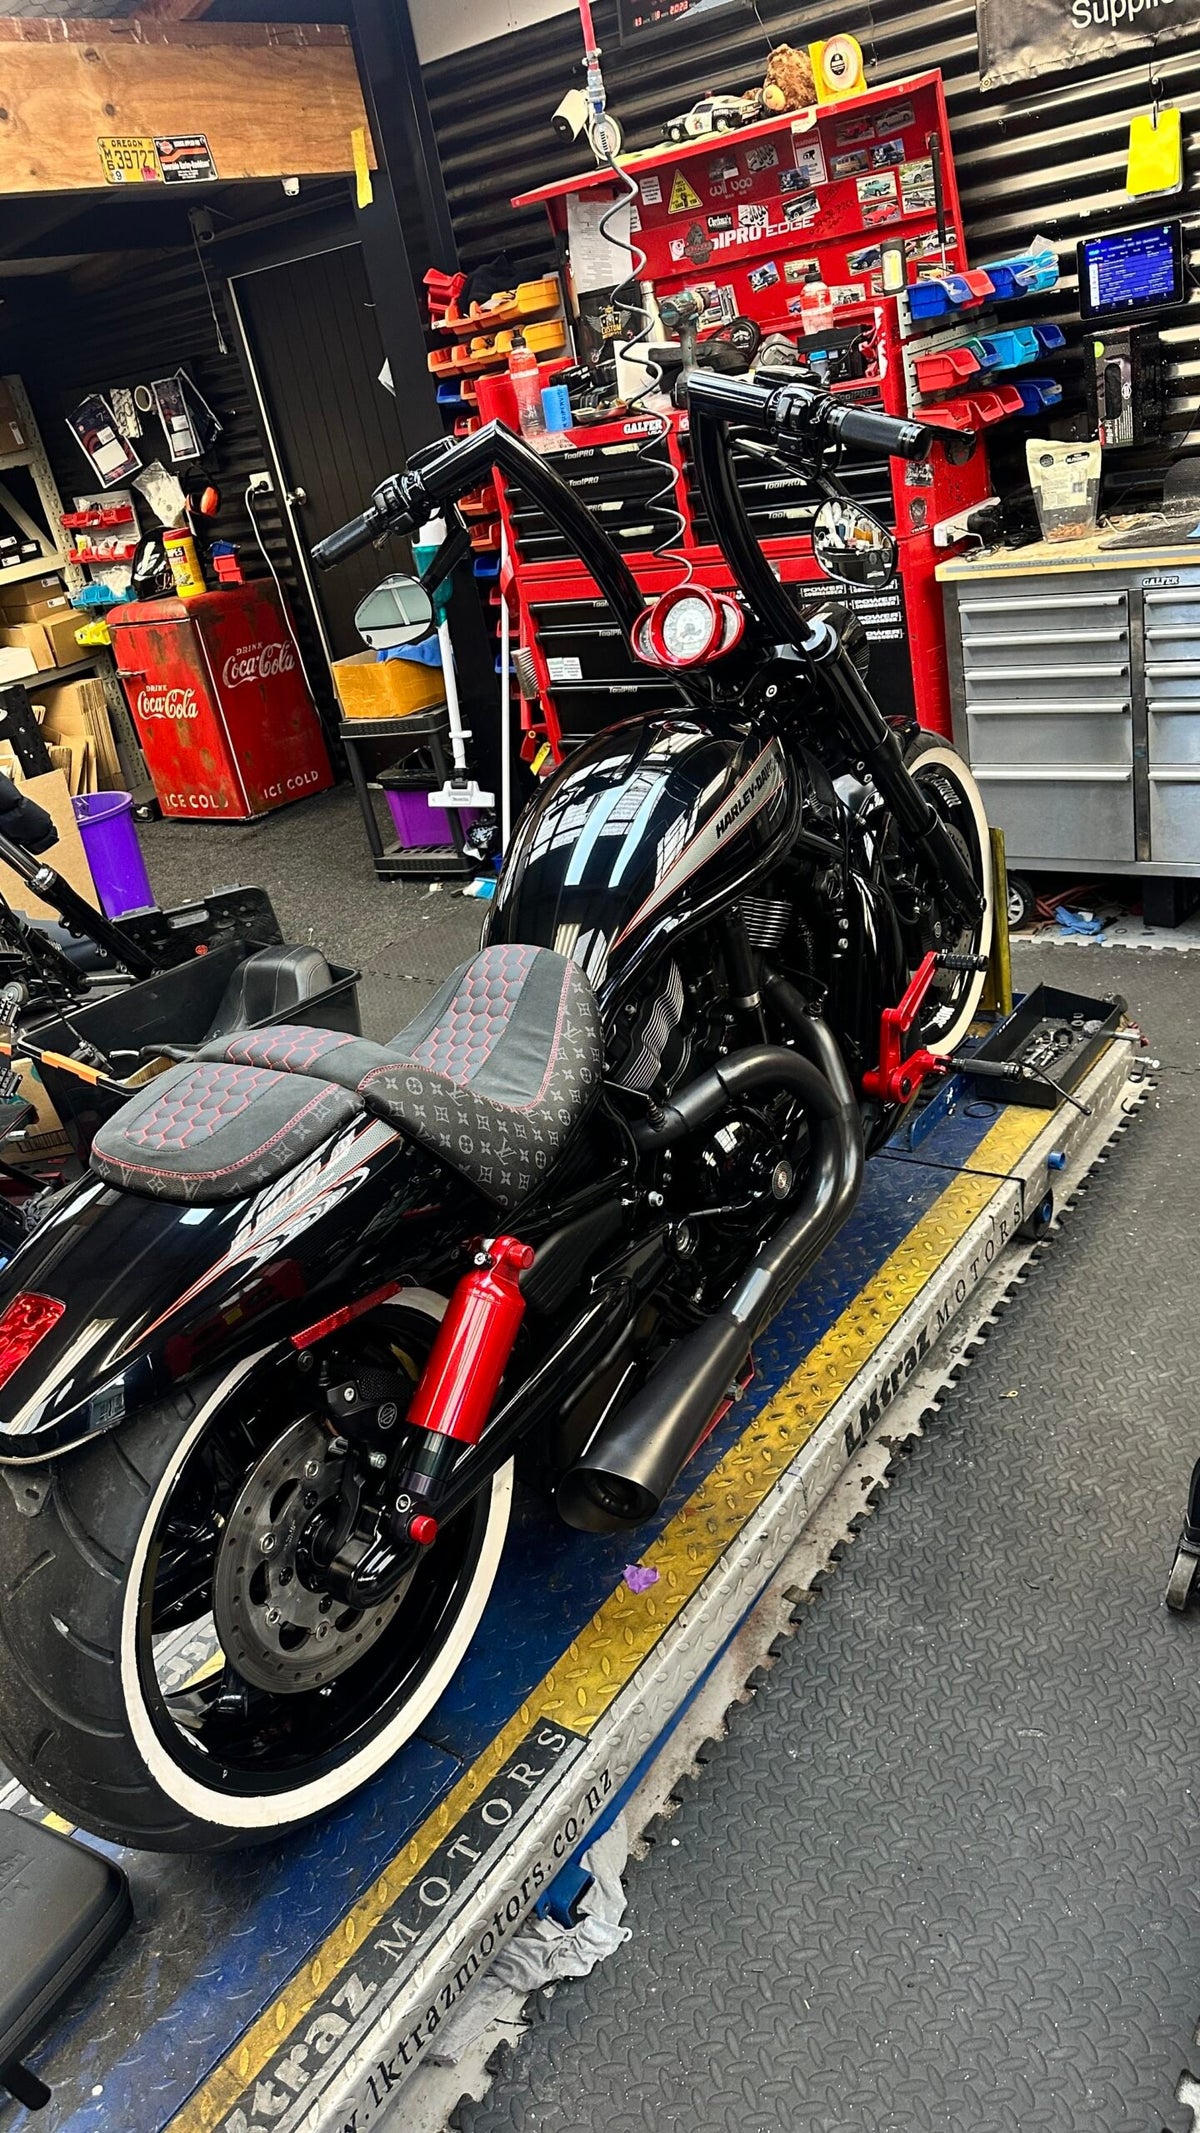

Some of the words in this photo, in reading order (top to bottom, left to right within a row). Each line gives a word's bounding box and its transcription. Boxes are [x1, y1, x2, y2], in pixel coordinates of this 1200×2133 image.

[1072, 0, 1173, 29] Supp
[111, 139, 143, 147] OREGON
[114, 150, 157, 169] 39727
[711, 225, 761, 250] olPRO
[766, 215, 815, 238] EDGE
[624, 419, 663, 435] GALFER
[564, 448, 595, 460] ToolPRO
[569, 476, 599, 487] ToolPRO
[803, 584, 844, 593] POWER
[1142, 576, 1180, 586] GALFER
[854, 596, 897, 605] POWER
[598, 629, 622, 637] ToolPR
[866, 629, 900, 637] OWER
[236, 641, 264, 656] DRINK
[145, 684, 168, 692] DRINK
[137, 687, 199, 720] Coca-Cola
[286, 769, 320, 791] COLD
[163, 793, 187, 808] ICE
[935, 1202, 1021, 1333] MOTORS
[373, 1727, 567, 1962] MOTORS
